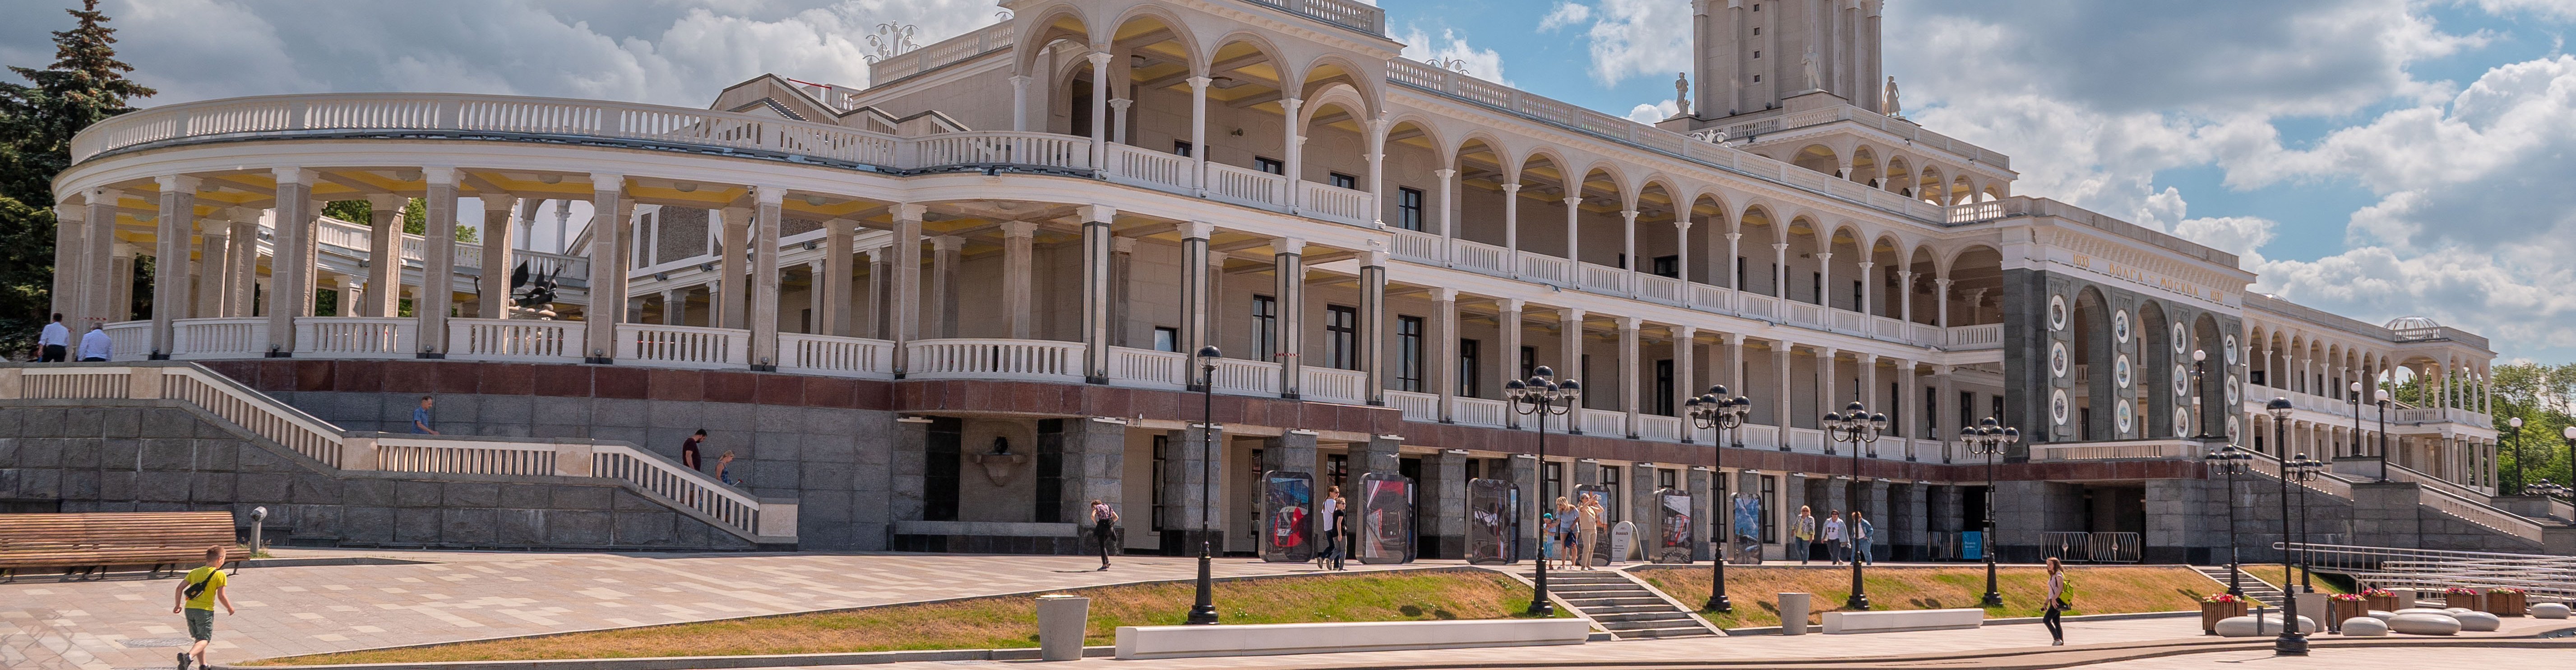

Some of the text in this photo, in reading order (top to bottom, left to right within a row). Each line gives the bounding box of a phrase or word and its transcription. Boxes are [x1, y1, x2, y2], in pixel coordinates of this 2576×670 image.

[2073, 253, 2223, 303] 1933 ВОЛГА МОСКВА 1937
